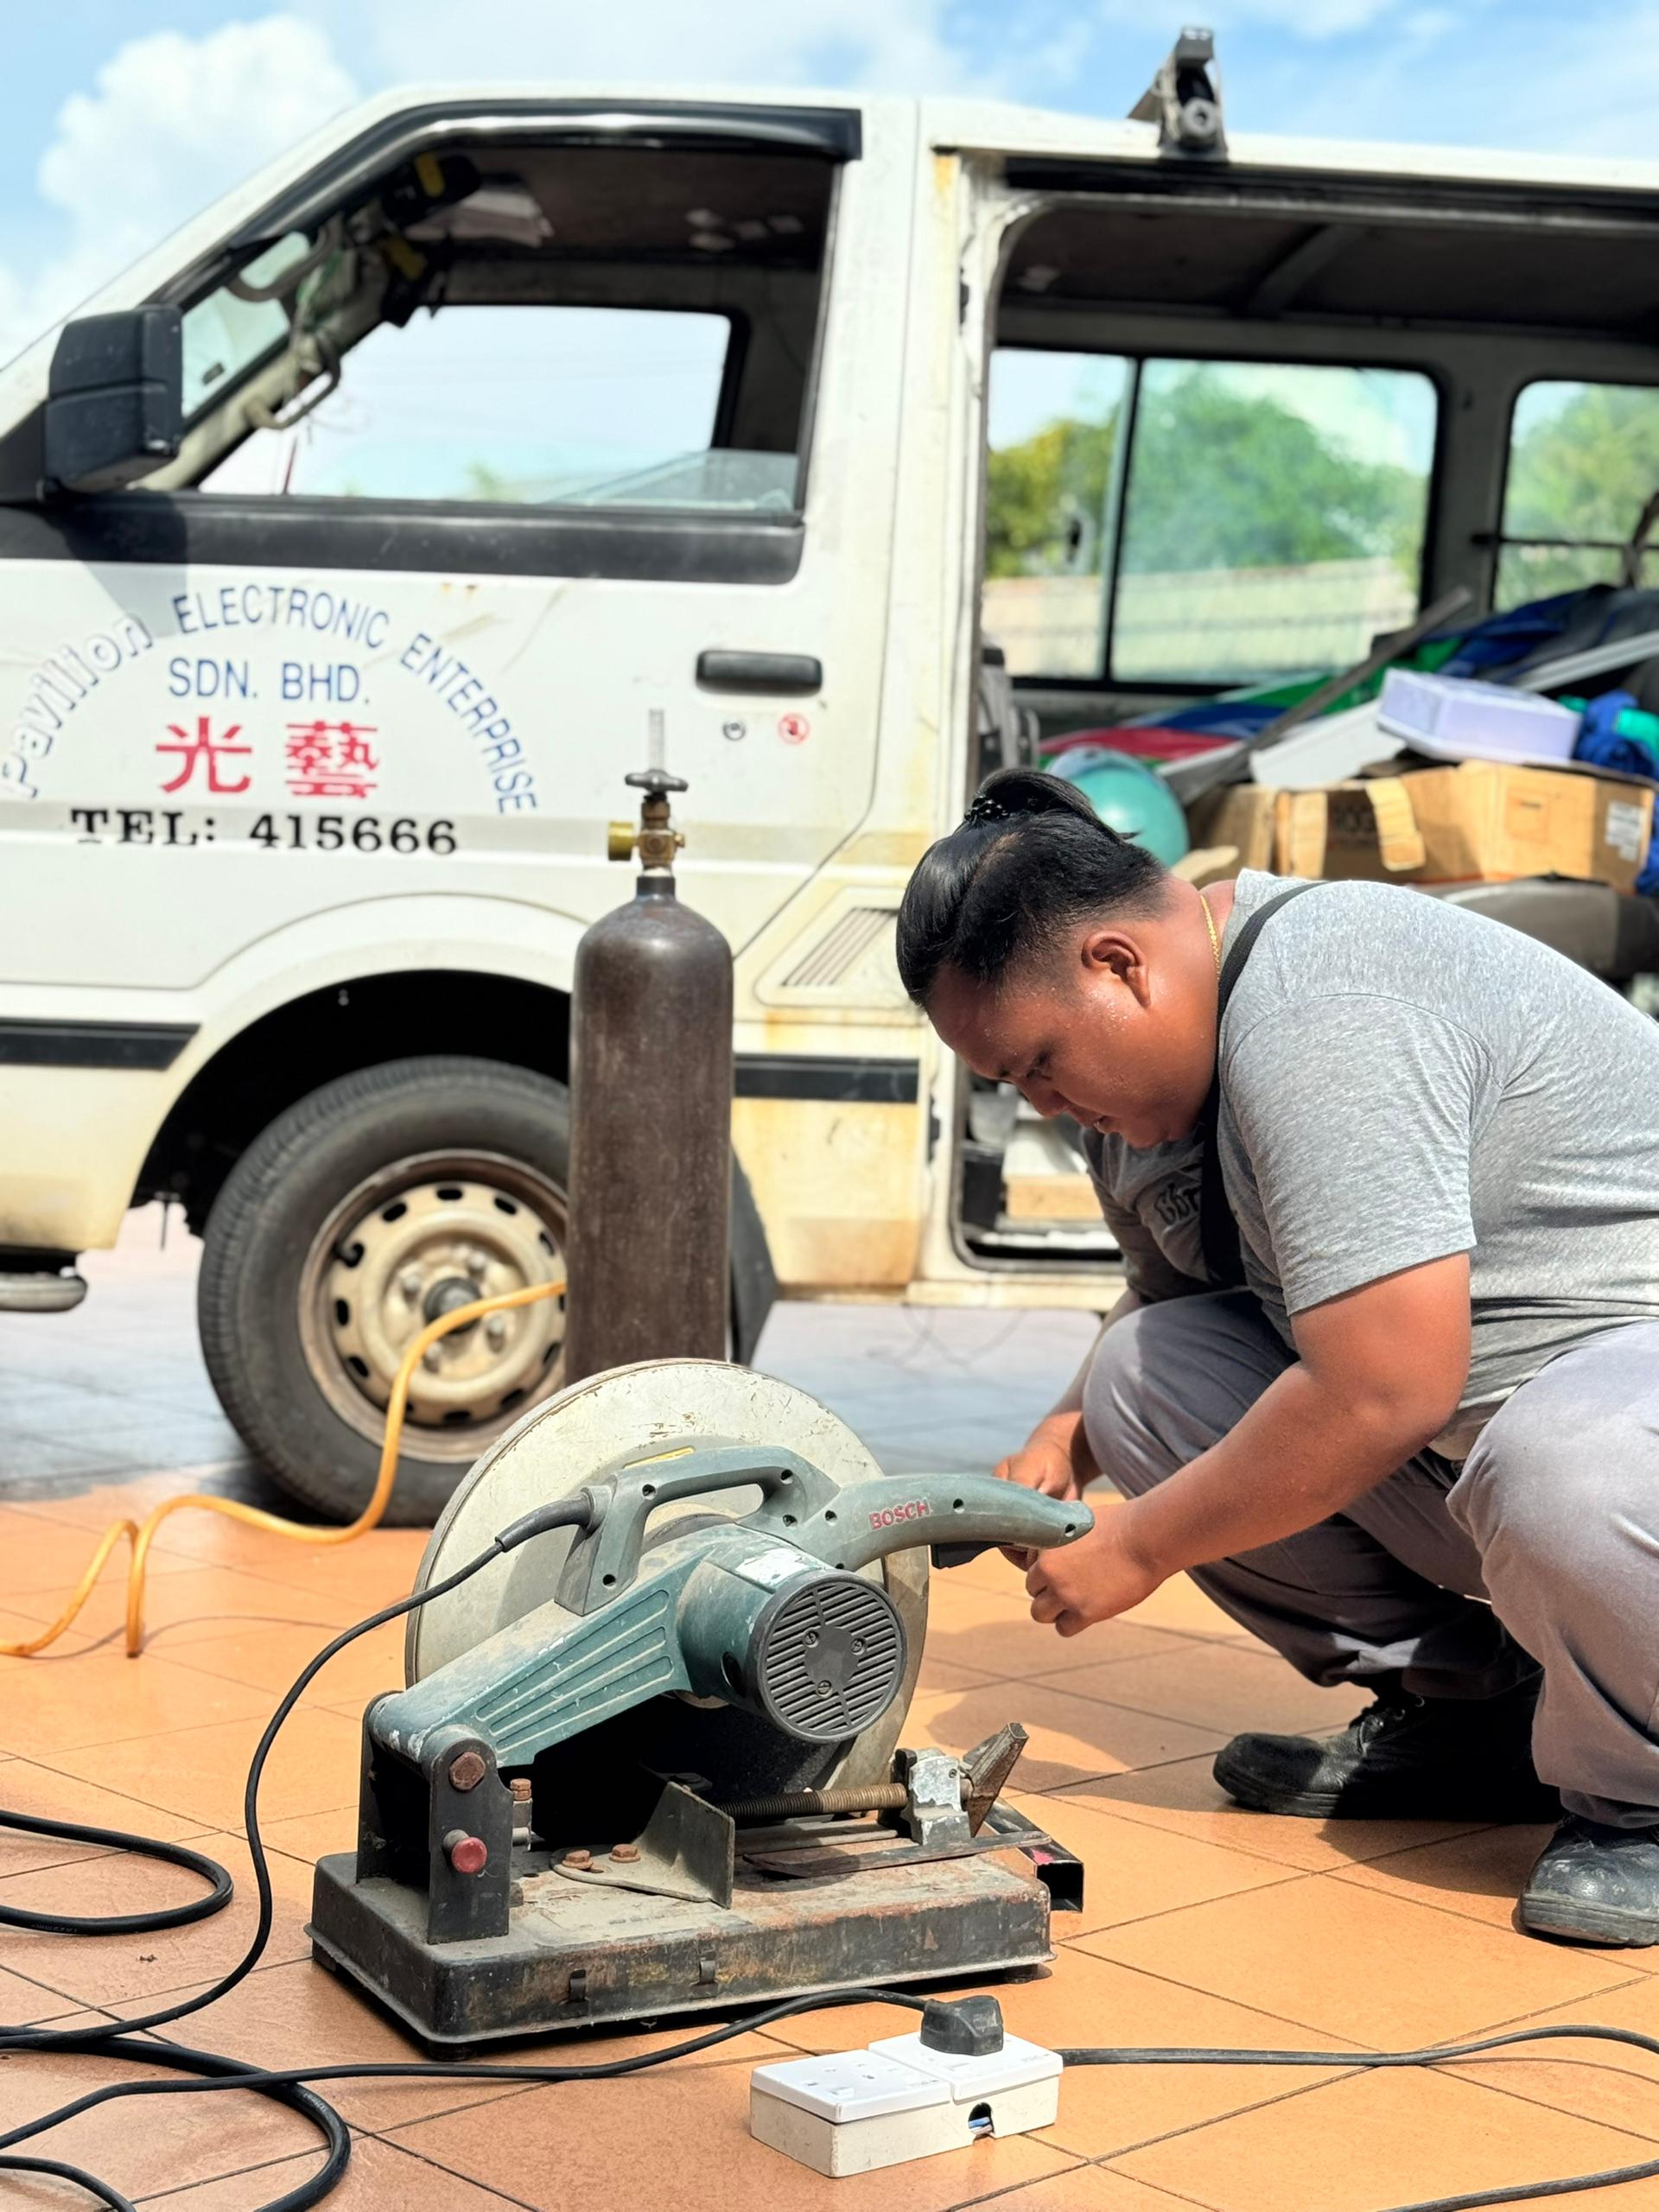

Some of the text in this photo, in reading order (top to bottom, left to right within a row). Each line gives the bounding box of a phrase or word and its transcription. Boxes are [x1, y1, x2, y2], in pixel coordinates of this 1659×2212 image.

[0, 585, 537, 814] Pavilion ELECTRONIC ENTERPRISE
[168, 657, 370, 705] SDN. BHD.
[71, 809, 458, 855] TEL: 415666
[869, 1499, 930, 1530] BOSCH
